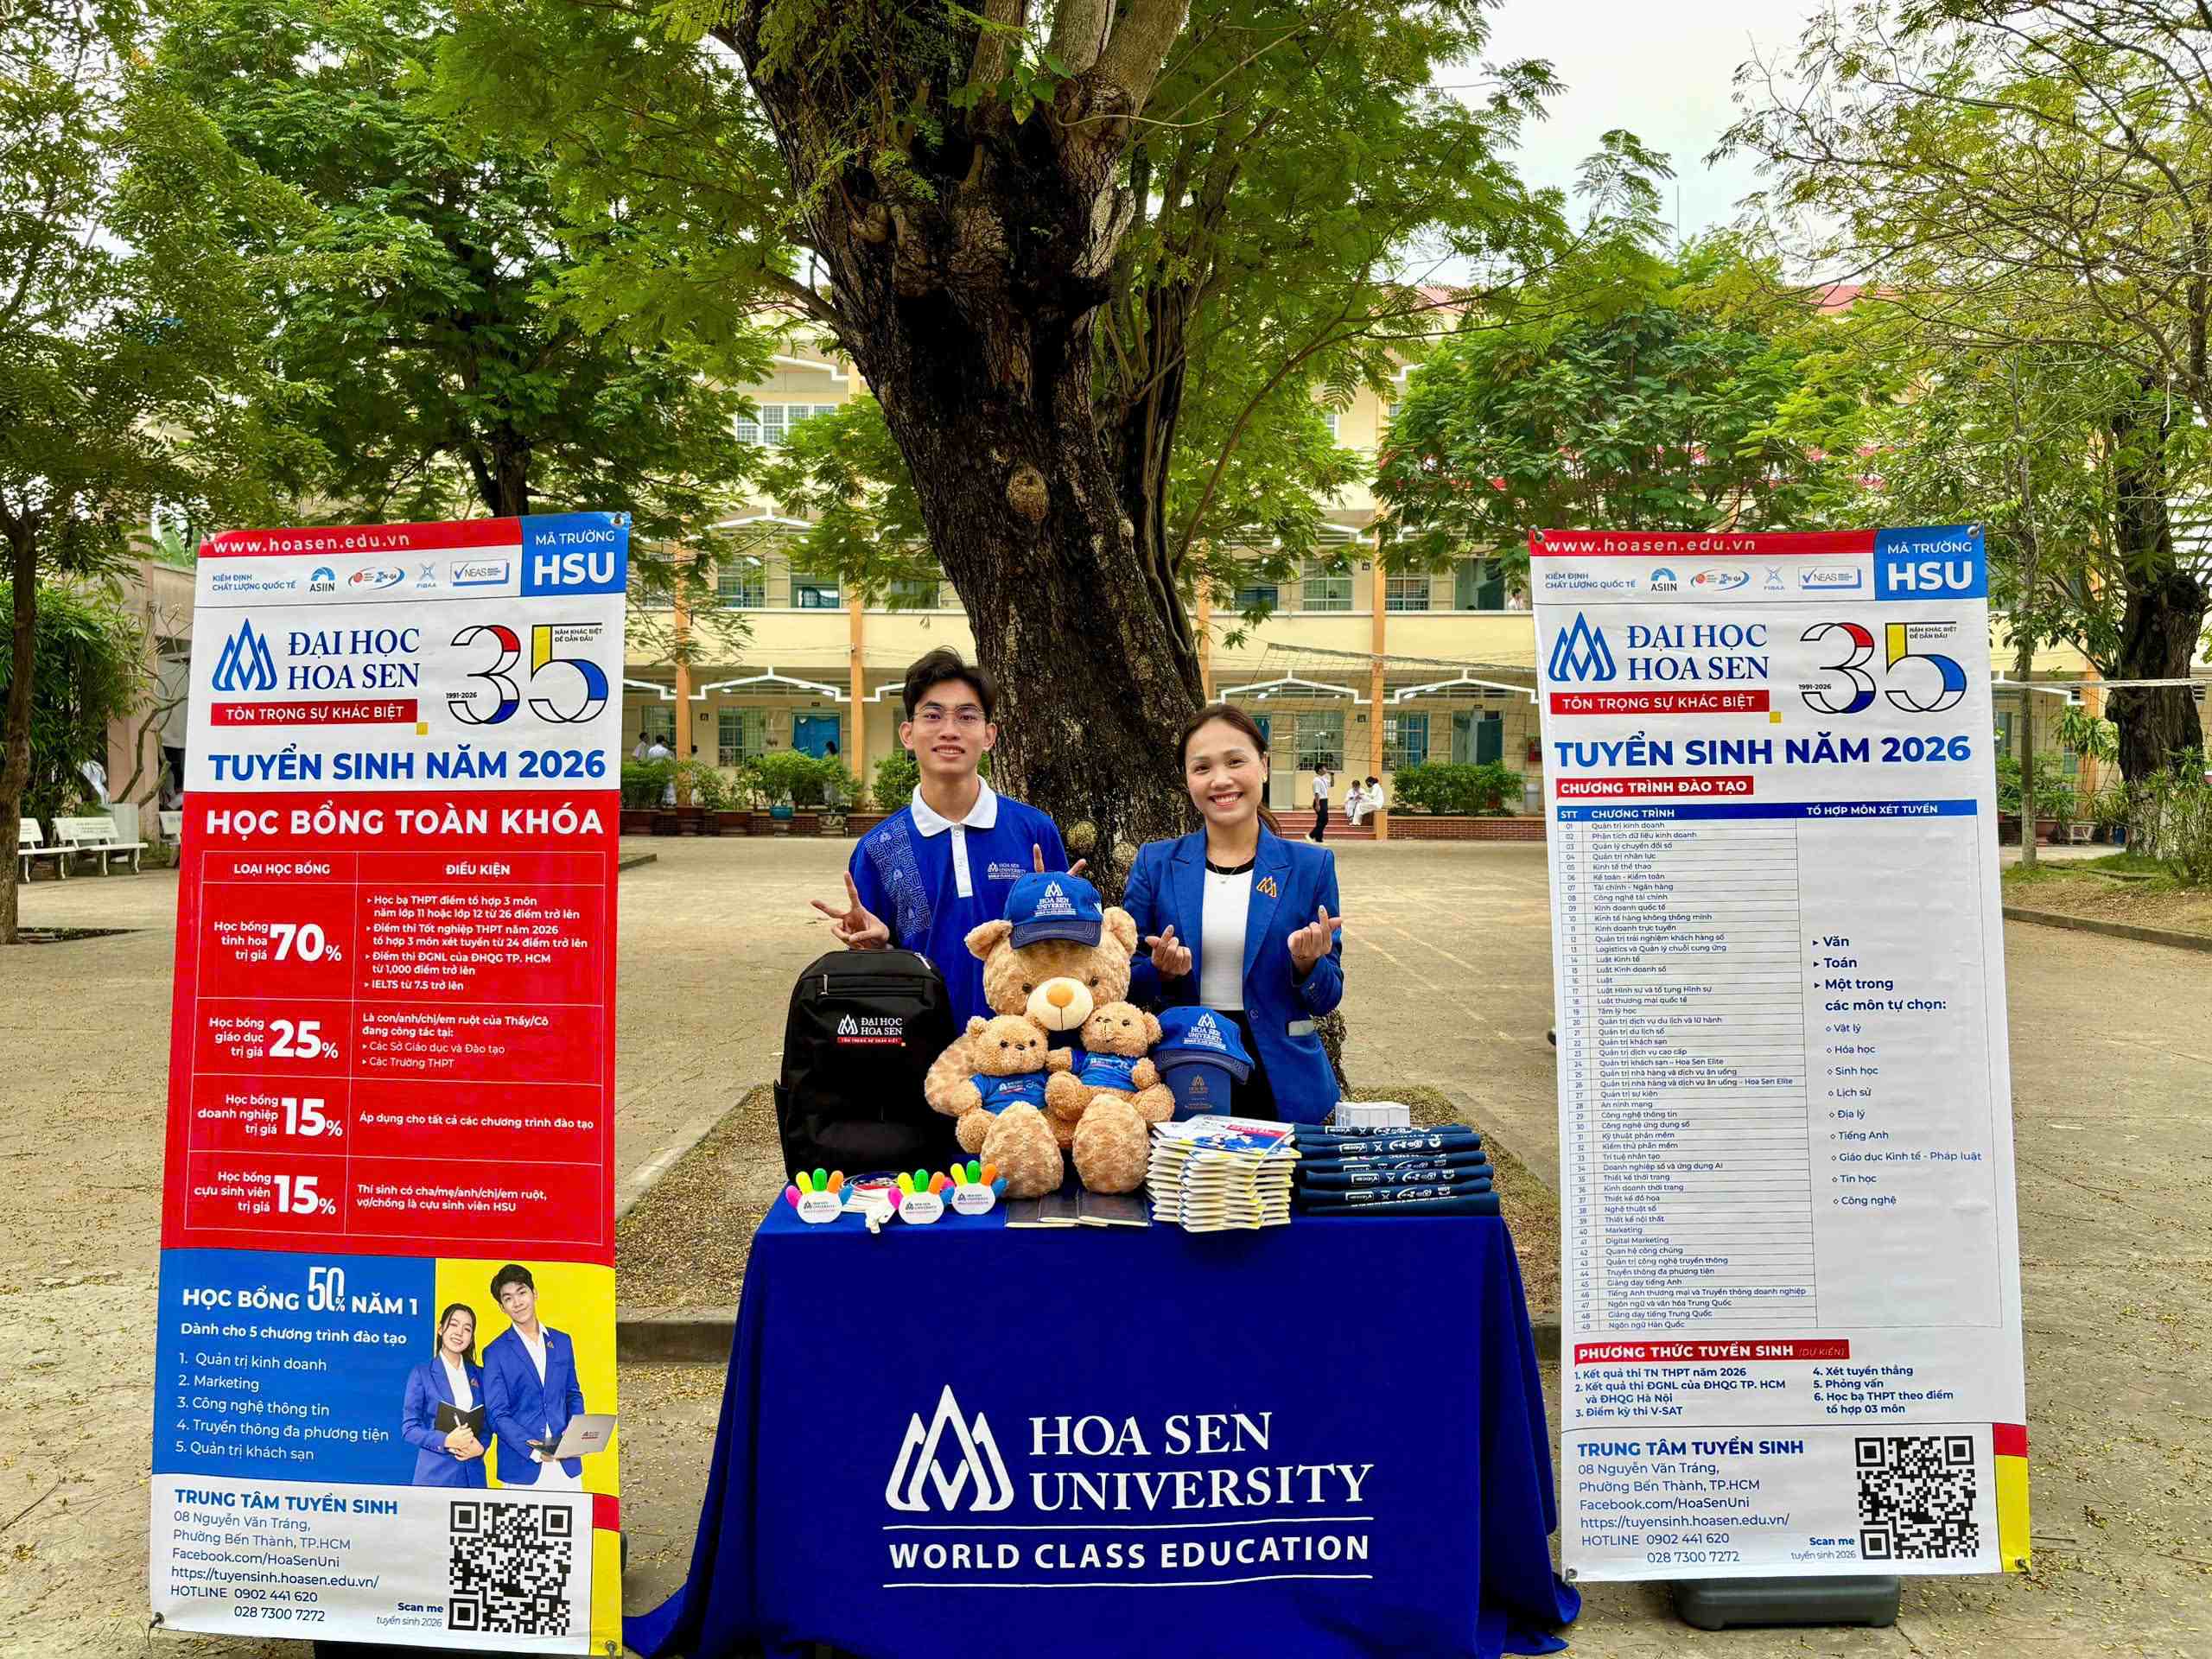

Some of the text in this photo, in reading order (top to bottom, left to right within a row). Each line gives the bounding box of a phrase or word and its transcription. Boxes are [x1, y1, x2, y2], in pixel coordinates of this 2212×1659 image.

[213, 532, 410, 554] www.hoasen.edu.vn
[535, 529, 615, 546] MÃ TRƯỜNG
[1544, 537, 1757, 553] www.hoasen.edu.vn
[1887, 540, 1972, 554] MÃ TRƯỜNG
[464, 567, 486, 578] NEAS
[534, 550, 613, 586] HSU
[1888, 560, 1972, 591] HSU
[213, 581, 232, 592] CHẤT
[262, 581, 284, 590] QUỐC
[285, 578, 297, 589] TẾ
[232, 574, 253, 582] ĐỊNH
[1815, 573, 1837, 582] NEAS
[309, 582, 335, 592] ASIIN
[1650, 582, 1677, 592] ASIIN
[288, 627, 420, 659] ĐẠI HỌC
[1627, 622, 1768, 652] ĐẠI HỌC
[288, 662, 420, 690] HOA SEN
[1627, 656, 1769, 681] HOA SEN
[226, 704, 404, 722] TÔN TRỌNG SỰ KHÁC BIỆT
[1554, 730, 1972, 769] TUYỂN SINH NĂM 2026
[207, 741, 606, 782] TUYỂN SINH NĂM 2026
[1560, 777, 1748, 794] CHƯƠNG TRÌNH ĐÀO TẠO
[1560, 806, 1675, 820] STT CHƯƠNG TRÌNH
[1825, 805, 1849, 817] HỢP
[1852, 804, 1875, 816] MÔN
[1878, 802, 1899, 815] XÉT
[1903, 801, 1938, 815] TUYỂN
[207, 799, 604, 842] HỌC BỔNG TOÀN KHÓA
[233, 860, 331, 878] LOẠI HỌC BỔNG
[446, 861, 511, 878] ĐIỀU KIỆN
[213, 919, 269, 936] Học bổng
[221, 934, 268, 947] tinh hoa
[1823, 935, 1850, 948] Văn
[235, 948, 267, 964] trị giá
[1824, 956, 1858, 969] Toán
[372, 980, 399, 991] IELTS
[414, 981, 429, 991] 7.5
[430, 980, 448, 991] trở
[449, 981, 464, 992] lên
[1824, 977, 1894, 992] Một trong
[1825, 997, 1947, 1013] các môn tự chọn:
[861, 1017, 903, 1027] ĐẠI HỌC
[1834, 1044, 1876, 1056] Hóa học
[1835, 1065, 1879, 1077] Sinh học
[1836, 1087, 1857, 1099] Lịch
[182, 1287, 232, 1313] HỌC
[238, 1284, 300, 1312] BỔNG
[351, 1291, 404, 1315] NĂM
[408, 1296, 418, 1316] 1
[181, 1321, 407, 1347] Dành cho 5 chương trình đào tạo
[1579, 1340, 1795, 1361] PHƯƠNG THỨC TUYỂN SINH
[178, 1374, 260, 1393] 2. Marketing
[1576, 1408, 1584, 1418] 3.
[1586, 1403, 1614, 1417] Điểm
[1633, 1405, 1648, 1417] thi
[1650, 1405, 1683, 1417] V-SAT
[1028, 1410, 1274, 1457] HOA SEN
[1028, 1462, 1375, 1512] UNIVERSITY
[1579, 1478, 1760, 1494] Phường Bến Thành, TP.HCM
[175, 1489, 398, 1516] TRUNG TÂM TUYỂN SINH
[172, 1548, 340, 1570] Facebook.com/HoaSenUni
[887, 1534, 1370, 1570] WORLD CLASS EDUCATION
[1647, 1551, 1741, 1564] 028 7300 7272
[171, 1566, 380, 1590] https://tuyensinh.hoasen.edu.vn/
[170, 1585, 319, 1604] HOTLINE 0902 441 620
[397, 1601, 444, 1614] Scan me
